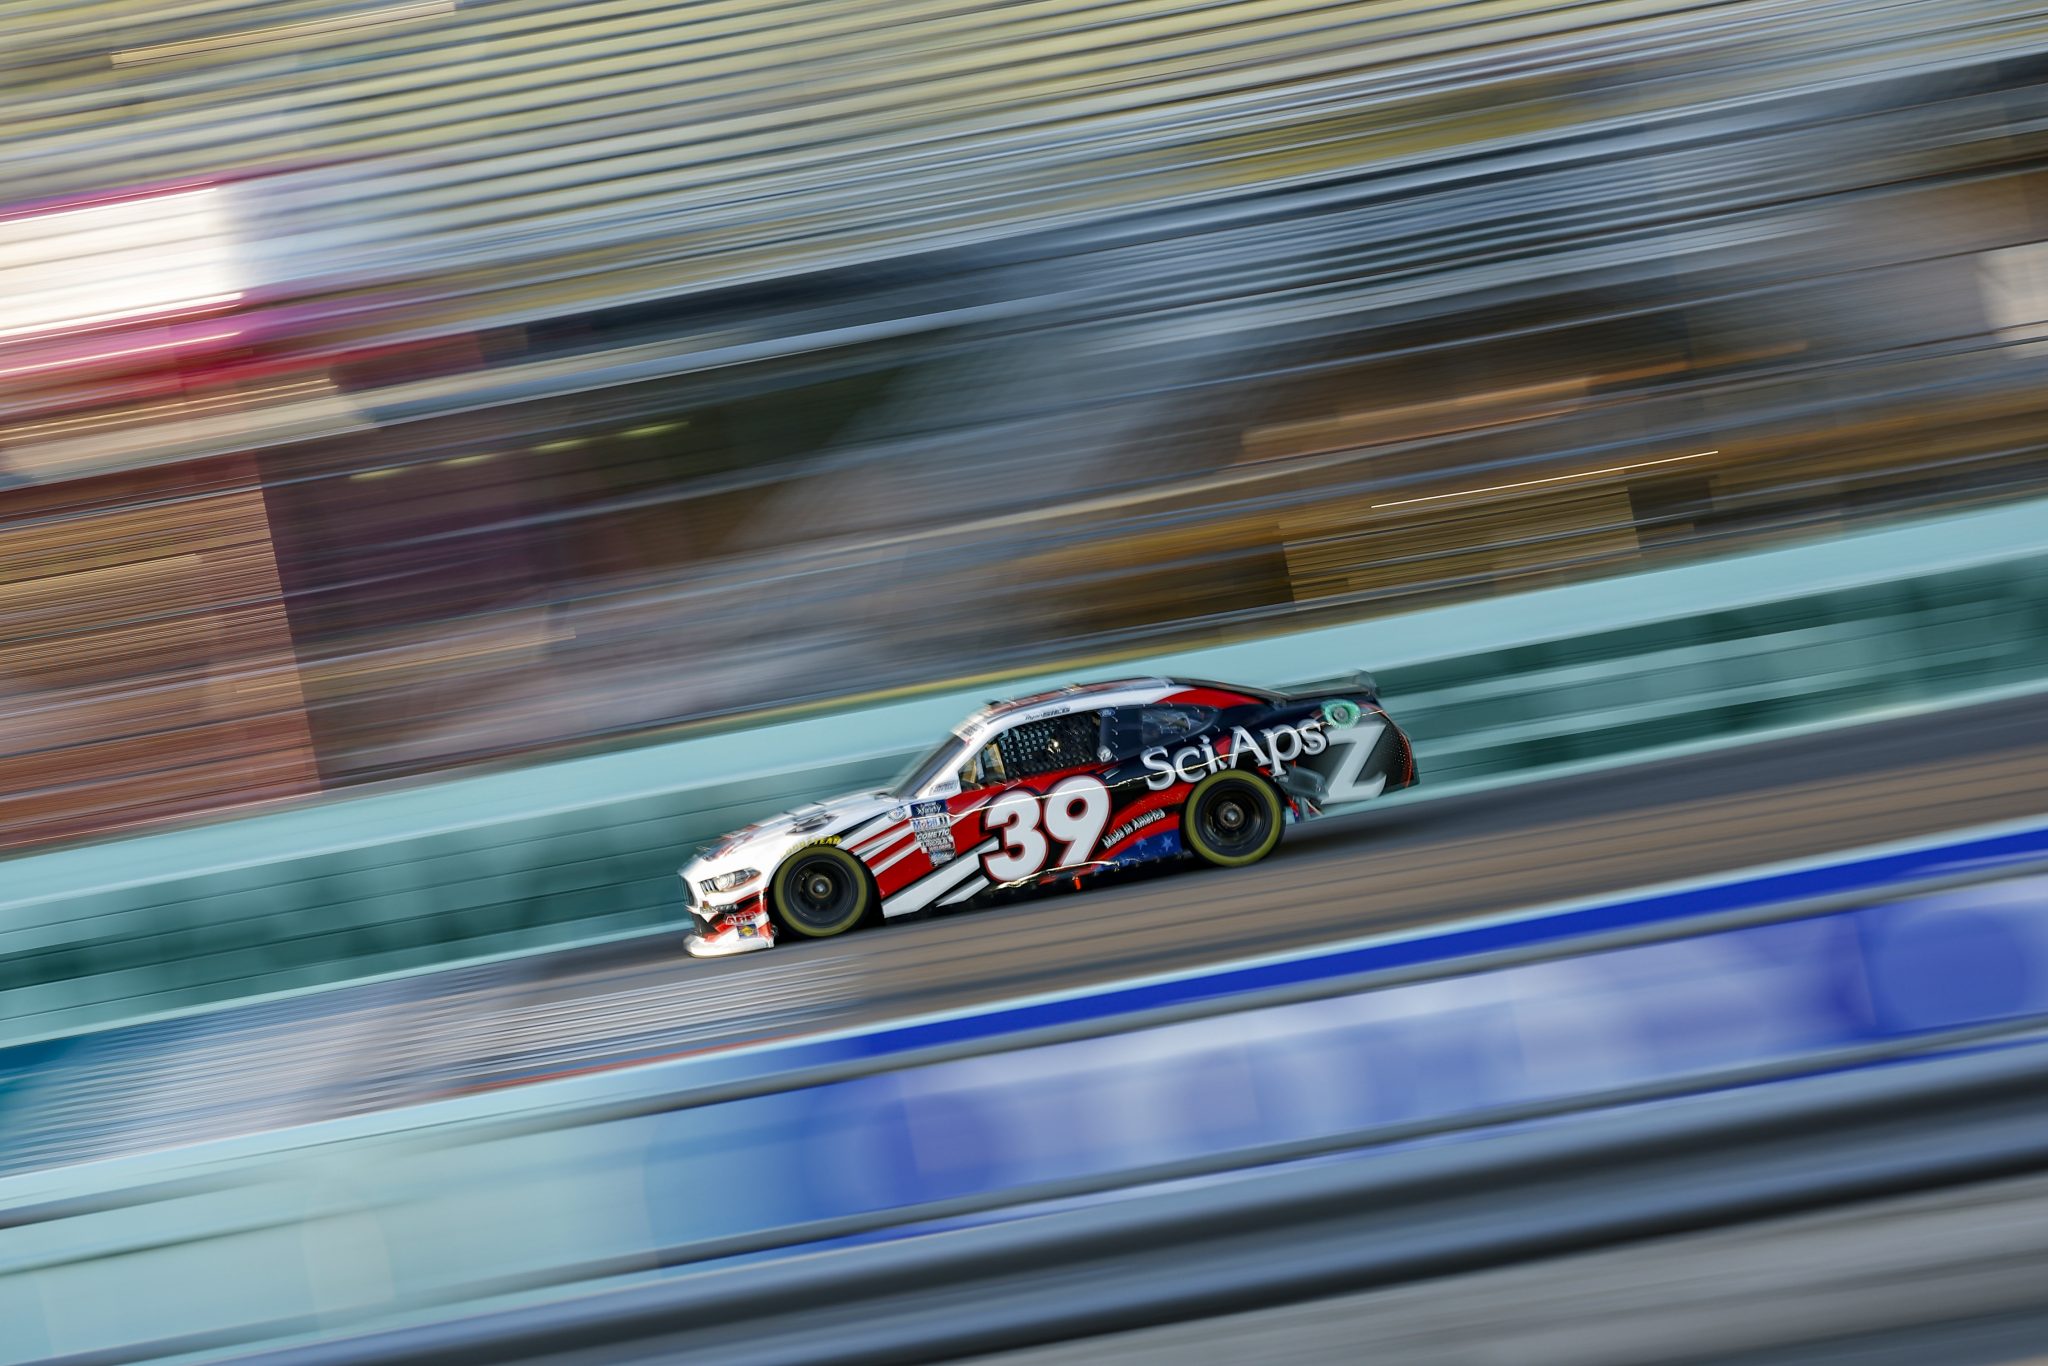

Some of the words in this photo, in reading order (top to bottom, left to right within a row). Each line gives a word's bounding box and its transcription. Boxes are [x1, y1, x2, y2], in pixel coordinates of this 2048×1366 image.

[1321, 718, 1388, 804] Z
[984, 774, 1111, 881] 39
[1101, 828, 1125, 849] Made
[1121, 823, 1133, 835] in
[1131, 808, 1166, 830] America
